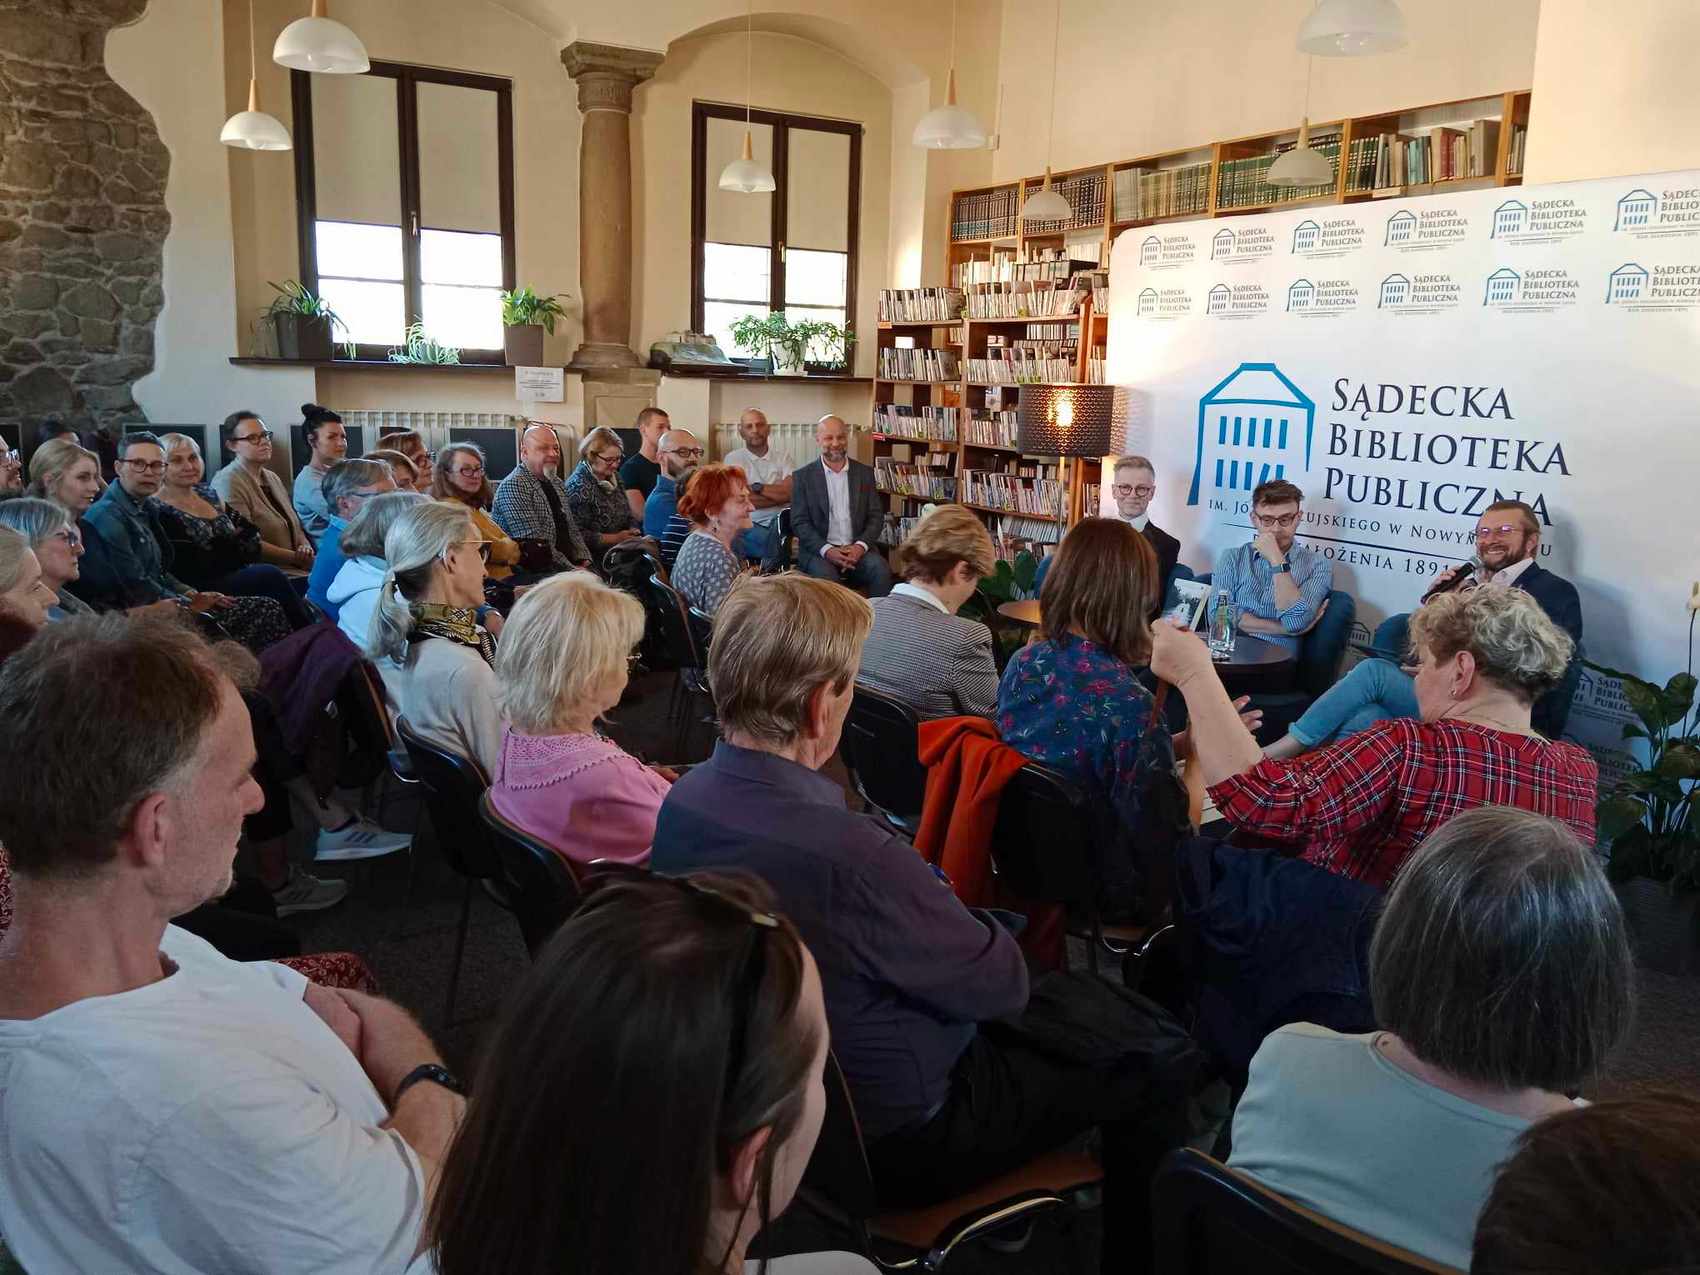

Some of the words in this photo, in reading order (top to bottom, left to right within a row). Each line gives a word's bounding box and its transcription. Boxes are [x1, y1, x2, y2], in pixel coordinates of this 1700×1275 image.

[1662, 188, 1700, 201] SĄDEC
[1661, 201, 1700, 212] BIBLIO
[1530, 209, 1587, 220] BIBLIOTEKA
[1660, 212, 1700, 223] PUBLIC
[1419, 219, 1468, 229] BIBLIOTEKA
[1529, 220, 1584, 231] PUBLICZNA
[1322, 228, 1365, 238] BIBLIOTEKA
[1418, 229, 1465, 239] PUBLICZNA
[1321, 238, 1363, 247] PUBLICZNA
[1412, 284, 1461, 293] BIBLIOTEKA
[1523, 280, 1580, 289] BIBLIOTEKA
[1316, 288, 1359, 297] BIBLIOTEKA
[1522, 291, 1576, 300] PUBLICZNA
[1650, 287, 1700, 297] PUBLICZ
[1315, 298, 1357, 306] PUBLICZNA
[1411, 294, 1459, 303] PUBLICZNA
[1331, 378, 1515, 421] SĄDECKA
[1327, 422, 1572, 476] BIBLIOTEKA
[1209, 499, 1228, 512] IM.
[1300, 511, 1381, 532] UJSKIEGO
[1389, 523, 1403, 535] W
[1594, 697, 1631, 713] PUBLIC
